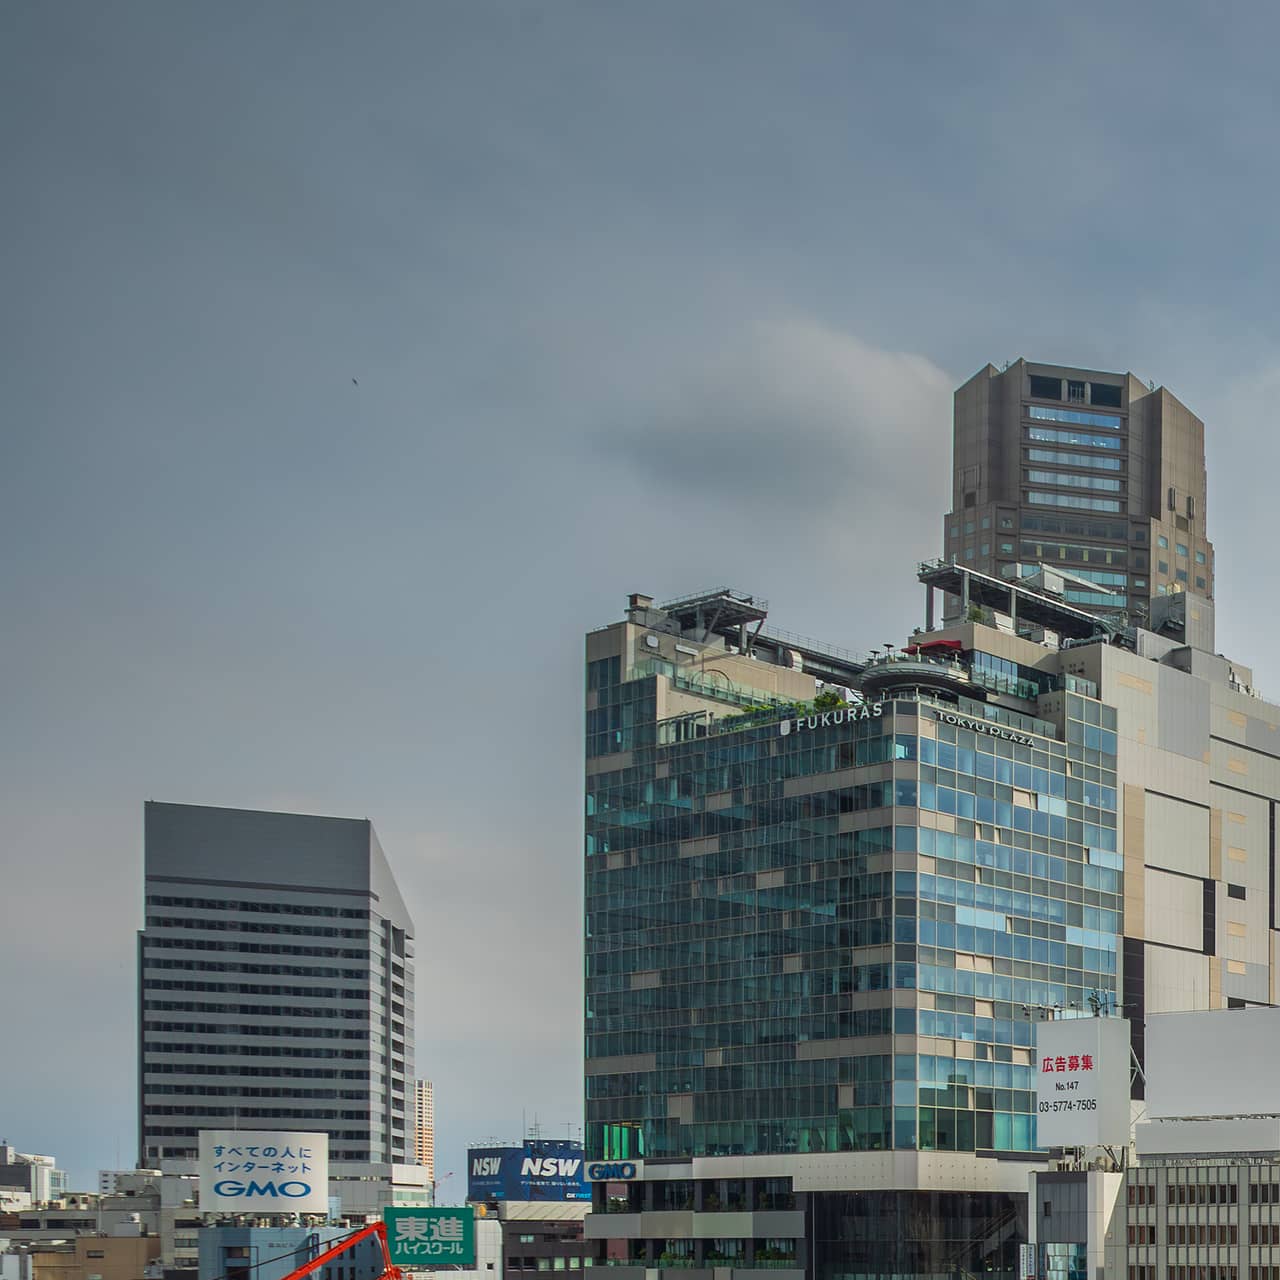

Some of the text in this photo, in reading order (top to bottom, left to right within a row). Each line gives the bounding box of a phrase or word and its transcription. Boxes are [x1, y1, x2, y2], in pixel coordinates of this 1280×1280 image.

[797, 702, 883, 733] FUKURAS
[938, 709, 1036, 748] TOKYU PLAZA
[1041, 1054, 1094, 1073] 広告募集
[1055, 1081, 1079, 1091] No.147
[1039, 1098, 1097, 1113] 03-5774-7505
[213, 1145, 312, 1159] すべての人に
[213, 1161, 311, 1174] インターネット
[472, 1157, 502, 1176] NSW
[520, 1157, 581, 1177] NSW
[588, 1162, 636, 1180] GMO
[213, 1180, 311, 1198] GMO
[395, 1216, 464, 1241] 東進
[395, 1242, 464, 1254] ハイスクール
